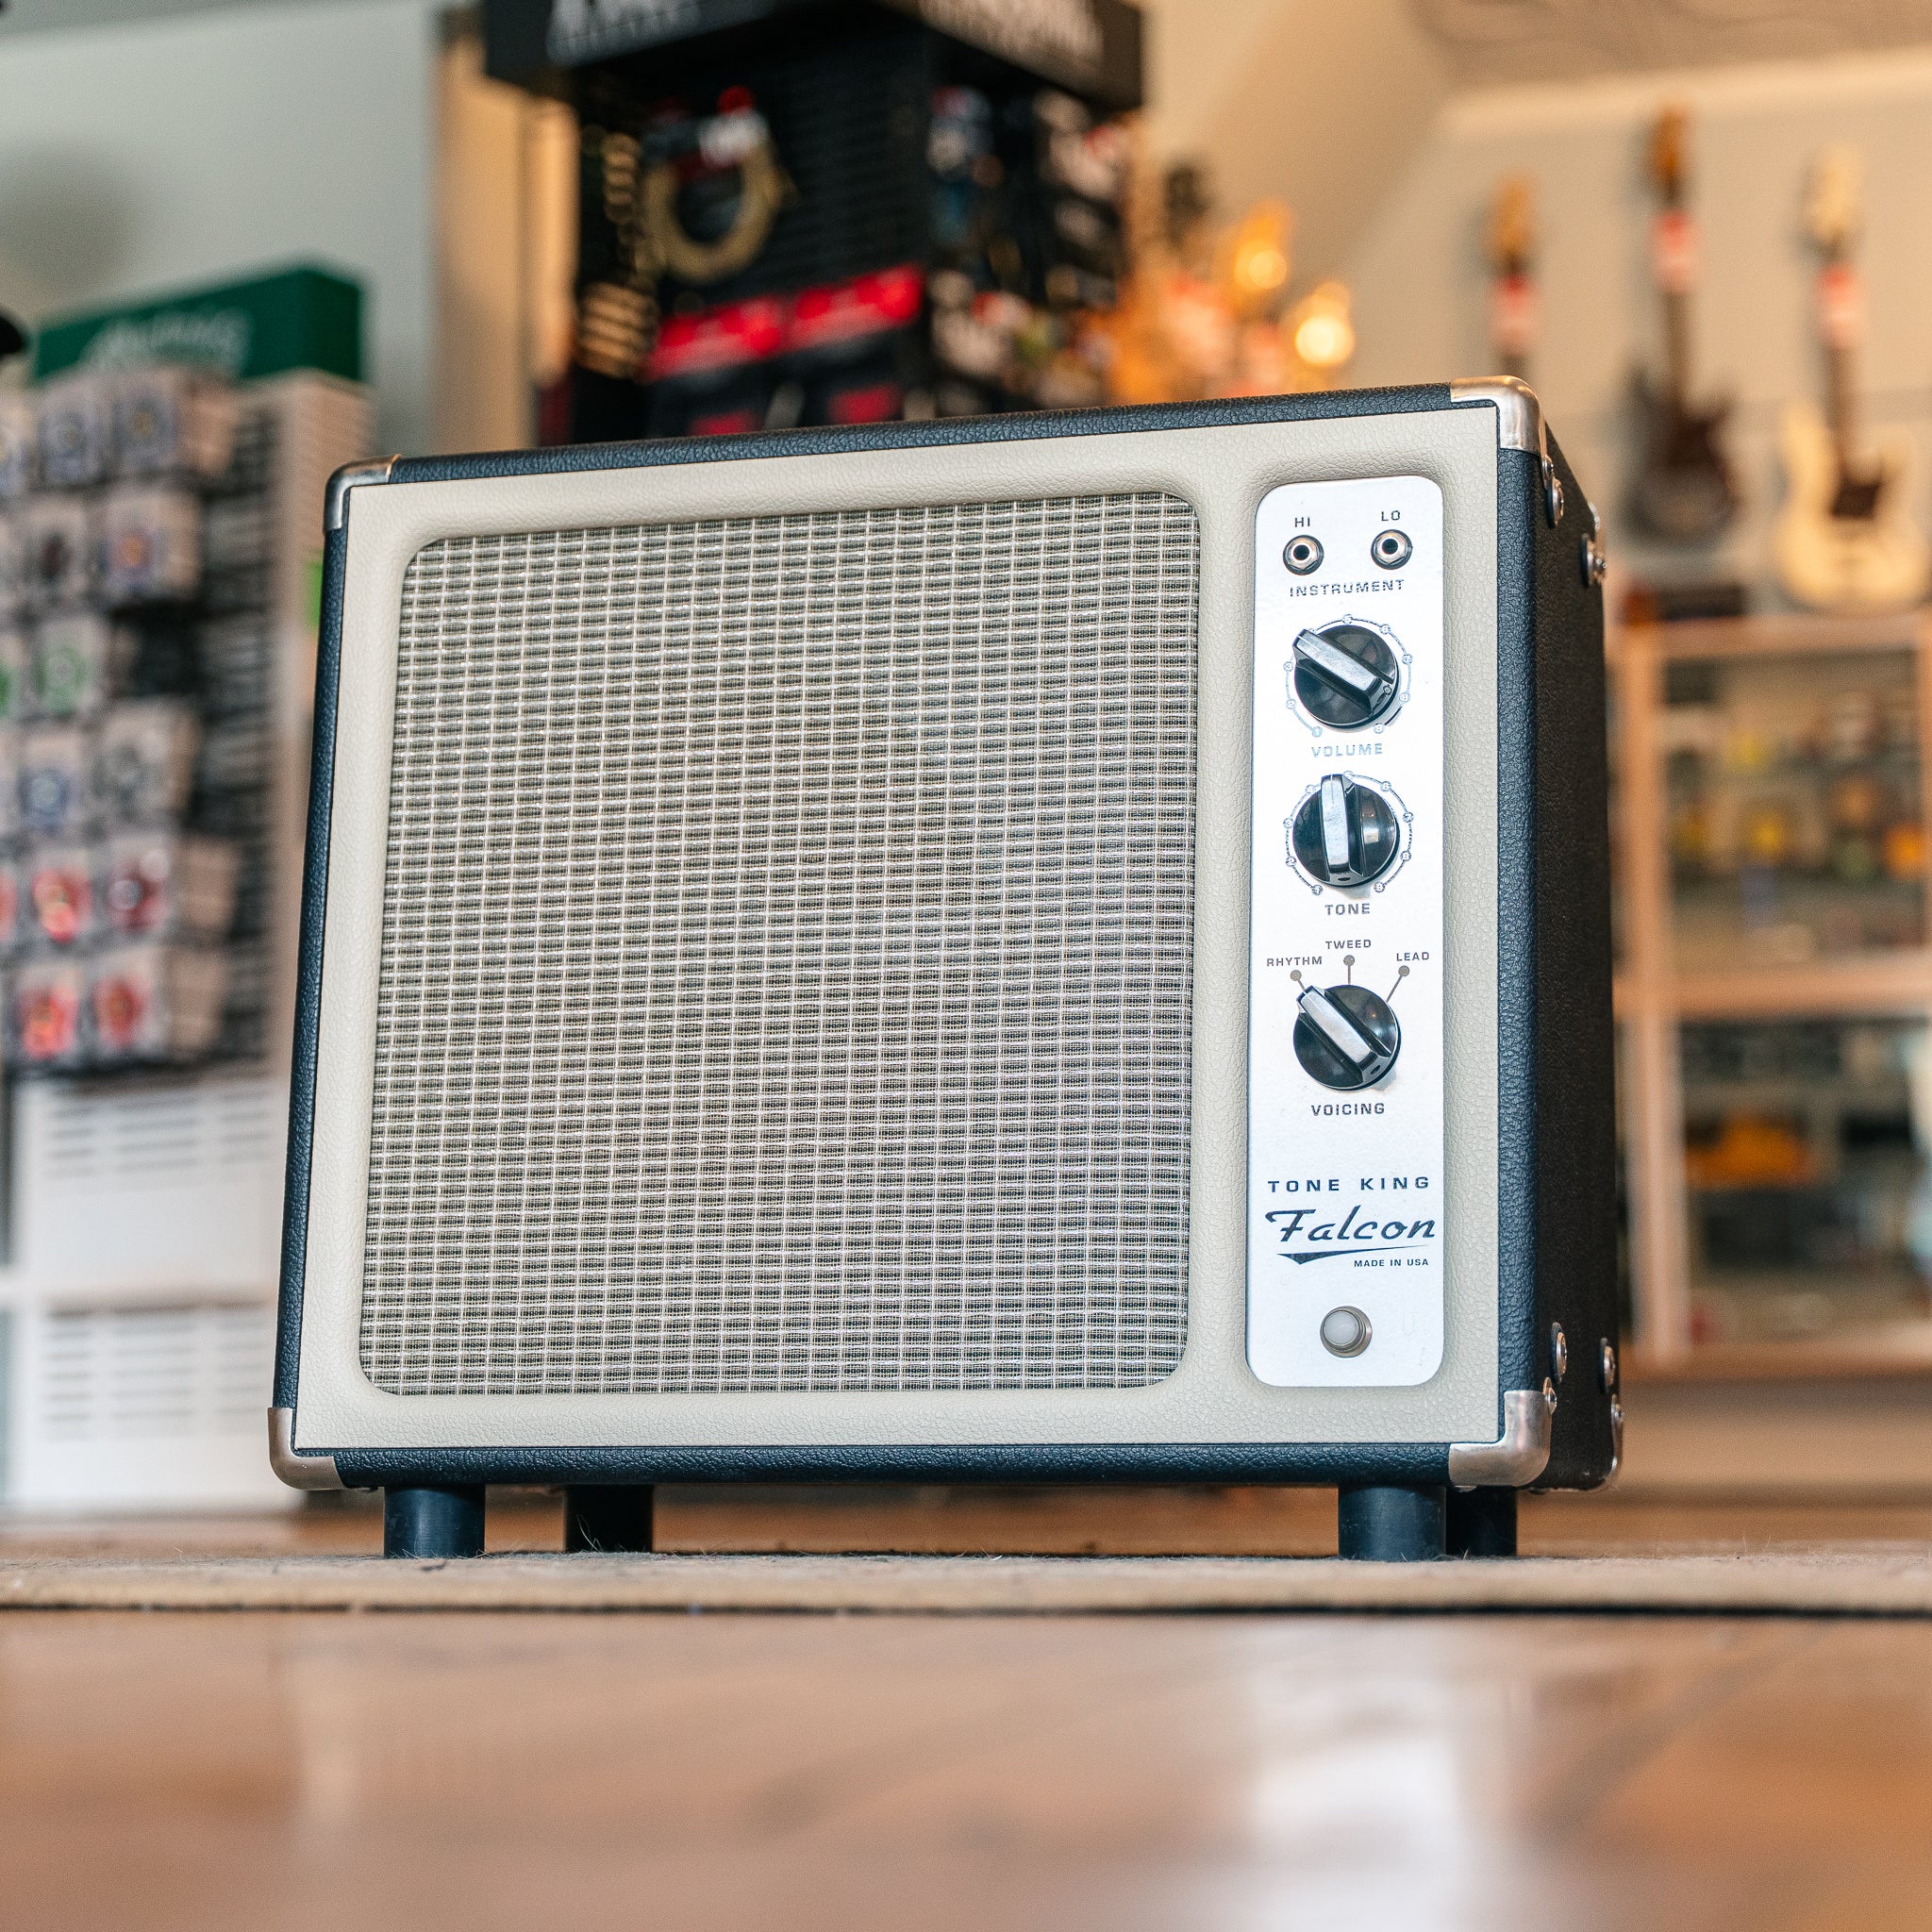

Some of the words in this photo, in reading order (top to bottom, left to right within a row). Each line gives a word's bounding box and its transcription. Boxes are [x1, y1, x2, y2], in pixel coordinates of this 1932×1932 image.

[1294, 516, 1311, 528] HI
[1380, 510, 1402, 522] LO
[1290, 579, 1405, 597] INSTRUMENT
[1311, 743, 1383, 758] VOLUME
[1324, 903, 1371, 916] TONE
[1325, 940, 1372, 950] TWEED
[1266, 956, 1323, 967] RHYTHM
[1396, 951, 1430, 962] LEAD
[1311, 1103, 1385, 1117] VOICING
[1268, 1179, 1340, 1193] TONE
[1360, 1176, 1429, 1191] KING
[1264, 1205, 1436, 1242] Falcon
[1354, 1259, 1385, 1268] MADE
[1390, 1258, 1402, 1267] IN
[1407, 1258, 1429, 1267] USA
